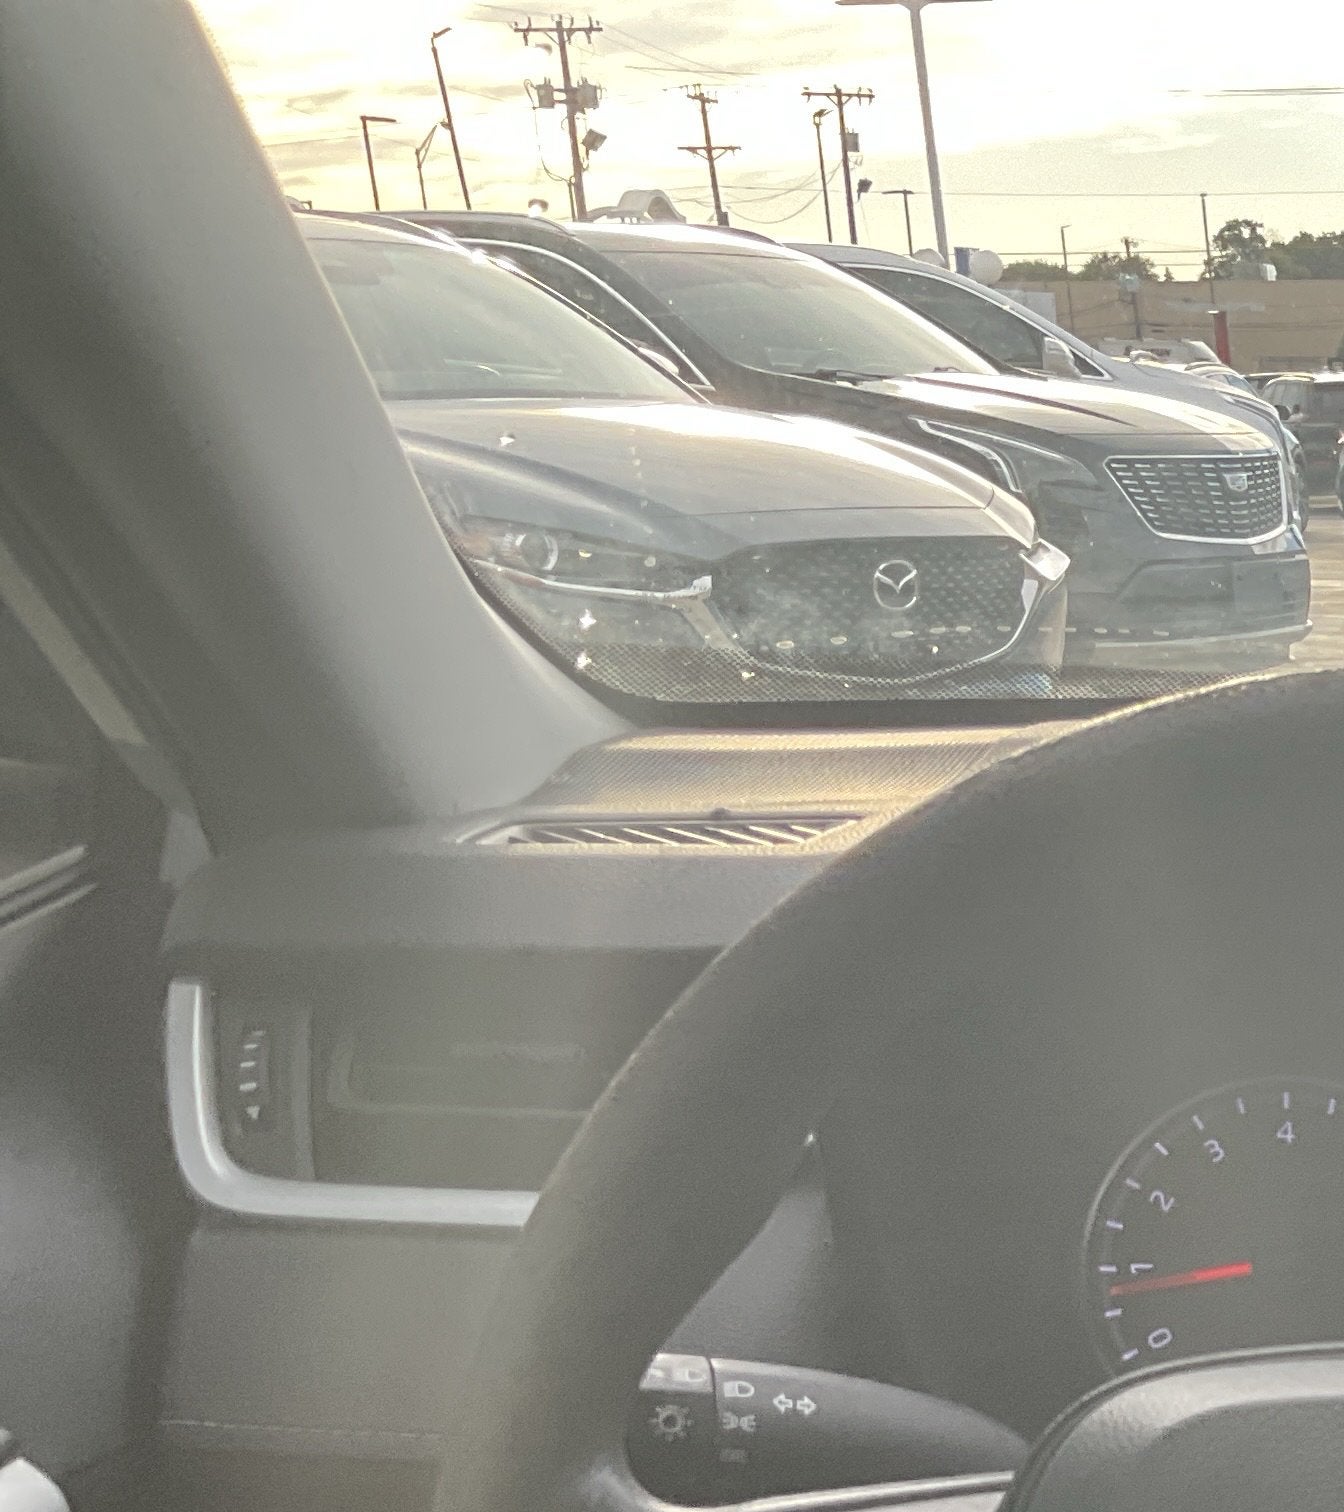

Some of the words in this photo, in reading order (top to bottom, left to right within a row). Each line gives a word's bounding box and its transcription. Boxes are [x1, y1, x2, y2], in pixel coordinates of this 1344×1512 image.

[1276, 1121, 1295, 1143] 4
[1204, 1139, 1225, 1163] 3
[1150, 1190, 1175, 1212] 2
[1130, 1262, 1154, 1274] 1
[1148, 1327, 1173, 1350] 0
